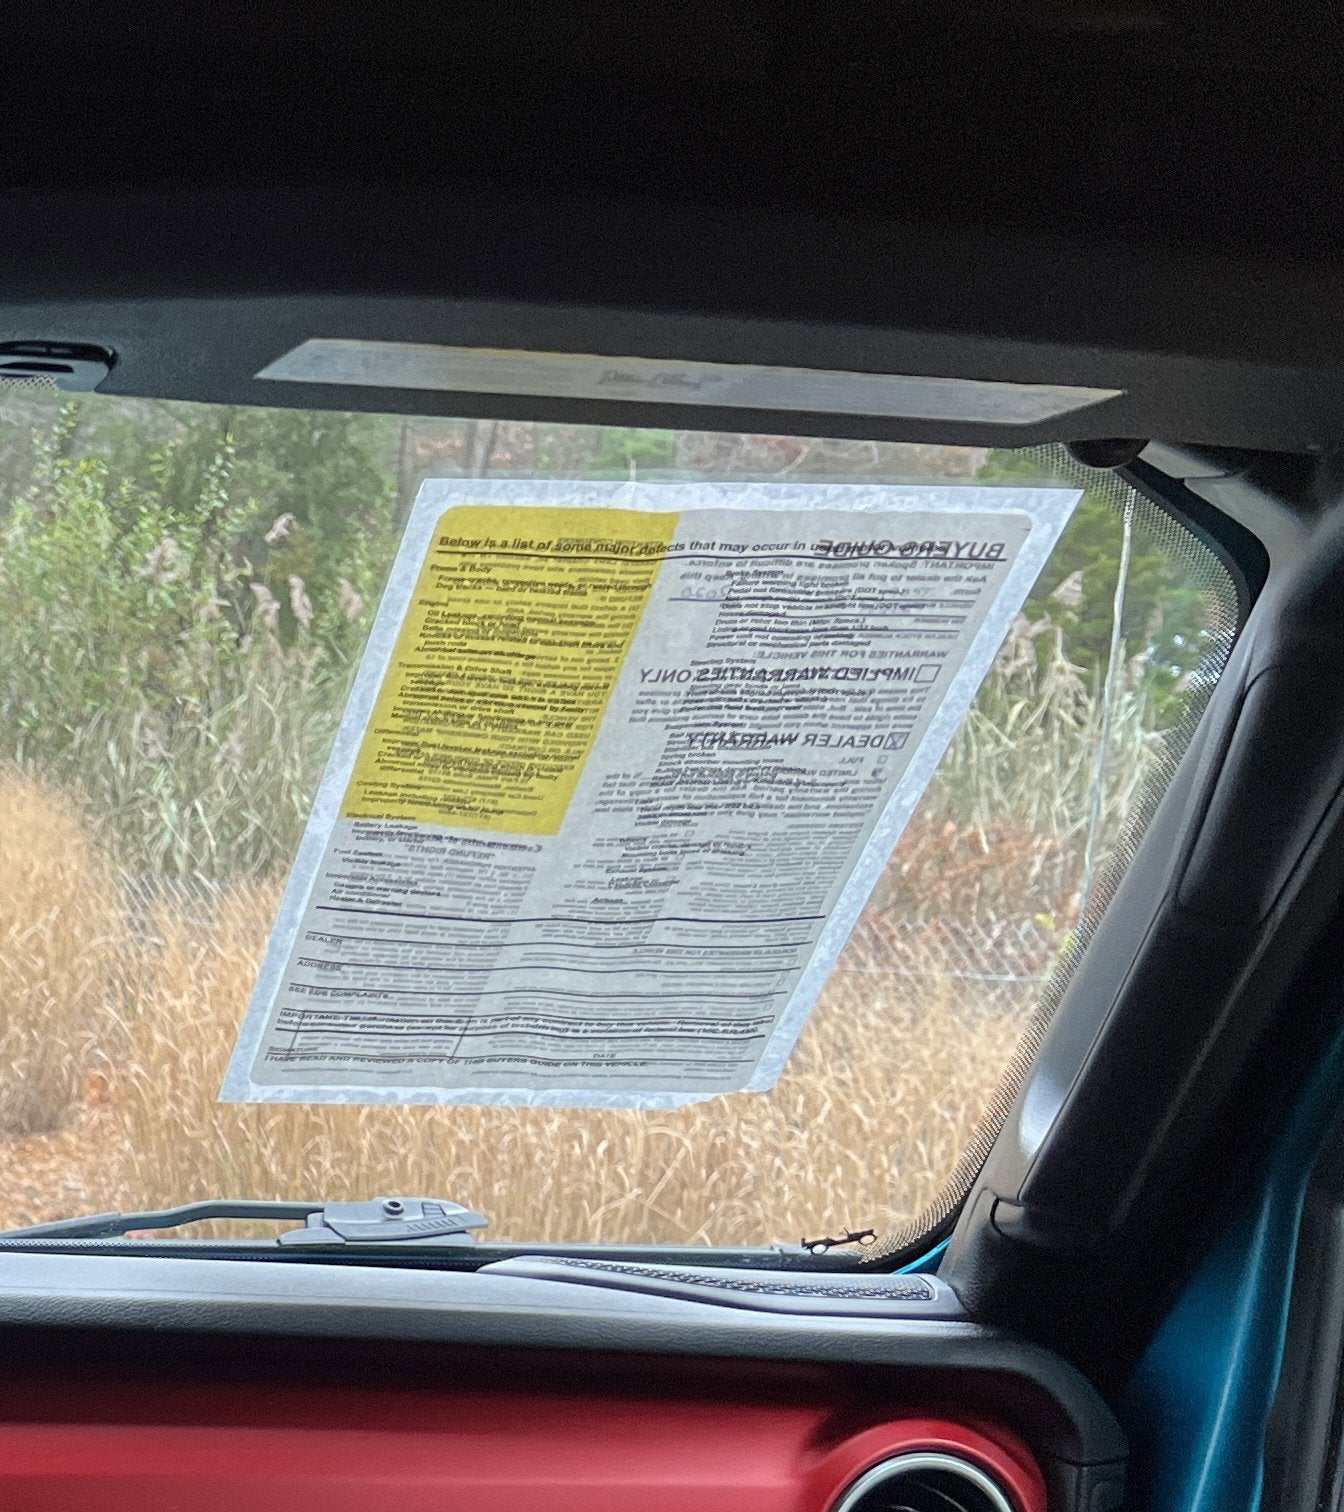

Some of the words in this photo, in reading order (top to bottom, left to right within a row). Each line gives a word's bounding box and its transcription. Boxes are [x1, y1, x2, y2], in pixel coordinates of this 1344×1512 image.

[439, 536, 481, 548] Below
[484, 538, 497, 548] is
[500, 540, 509, 548] a
[512, 538, 534, 549] list
[537, 540, 552, 551] of
[639, 542, 685, 556] defects
[689, 541, 716, 551] that
[719, 542, 749, 553] may
[751, 542, 792, 551] occur
[794, 541, 806, 550] in
